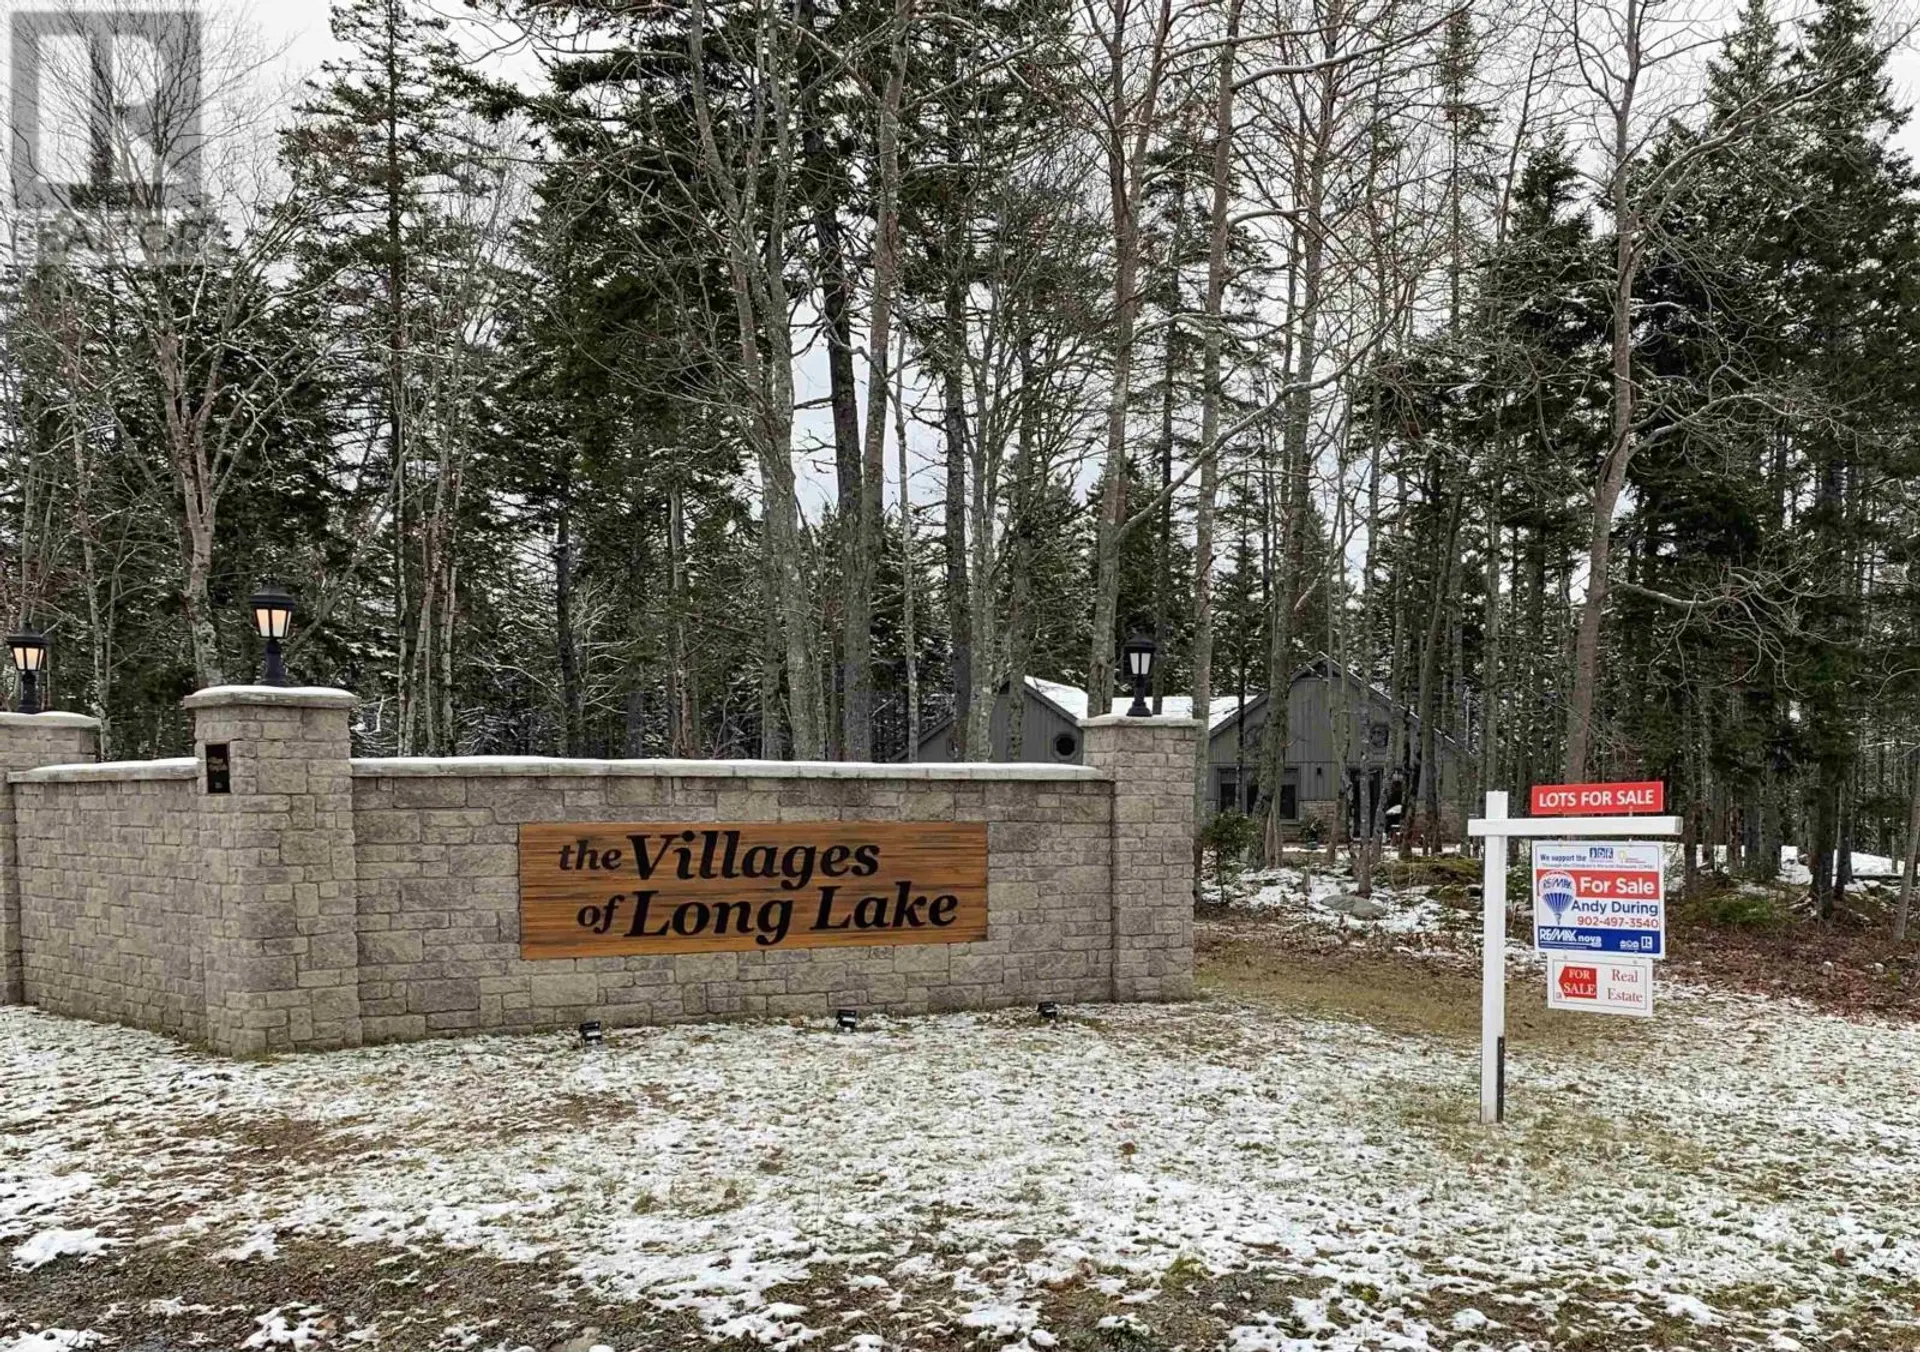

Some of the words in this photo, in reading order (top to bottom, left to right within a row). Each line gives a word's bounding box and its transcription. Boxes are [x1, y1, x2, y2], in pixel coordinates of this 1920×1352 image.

[1539, 792, 1577, 808] LOTS
[1581, 790, 1613, 806] FOR
[1617, 789, 1655, 805] SALE
[558, 839, 622, 872] the
[626, 830, 880, 890] Villages
[1551, 854, 1575, 862] support
[1580, 876, 1612, 893] For
[1616, 877, 1655, 895] Sale
[577, 894, 625, 935] of
[623, 889, 793, 945] Long
[809, 881, 958, 931] Lake
[1571, 900, 1607, 914] Andy
[1612, 901, 1659, 916] During
[1577, 916, 1659, 929] 902-497-3540
[1540, 928, 1577, 941] RE/MAX
[1569, 969, 1591, 979] FOR
[1612, 968, 1638, 983] Real
[1563, 983, 1597, 996] SALE
[1607, 987, 1643, 1002] Estate
